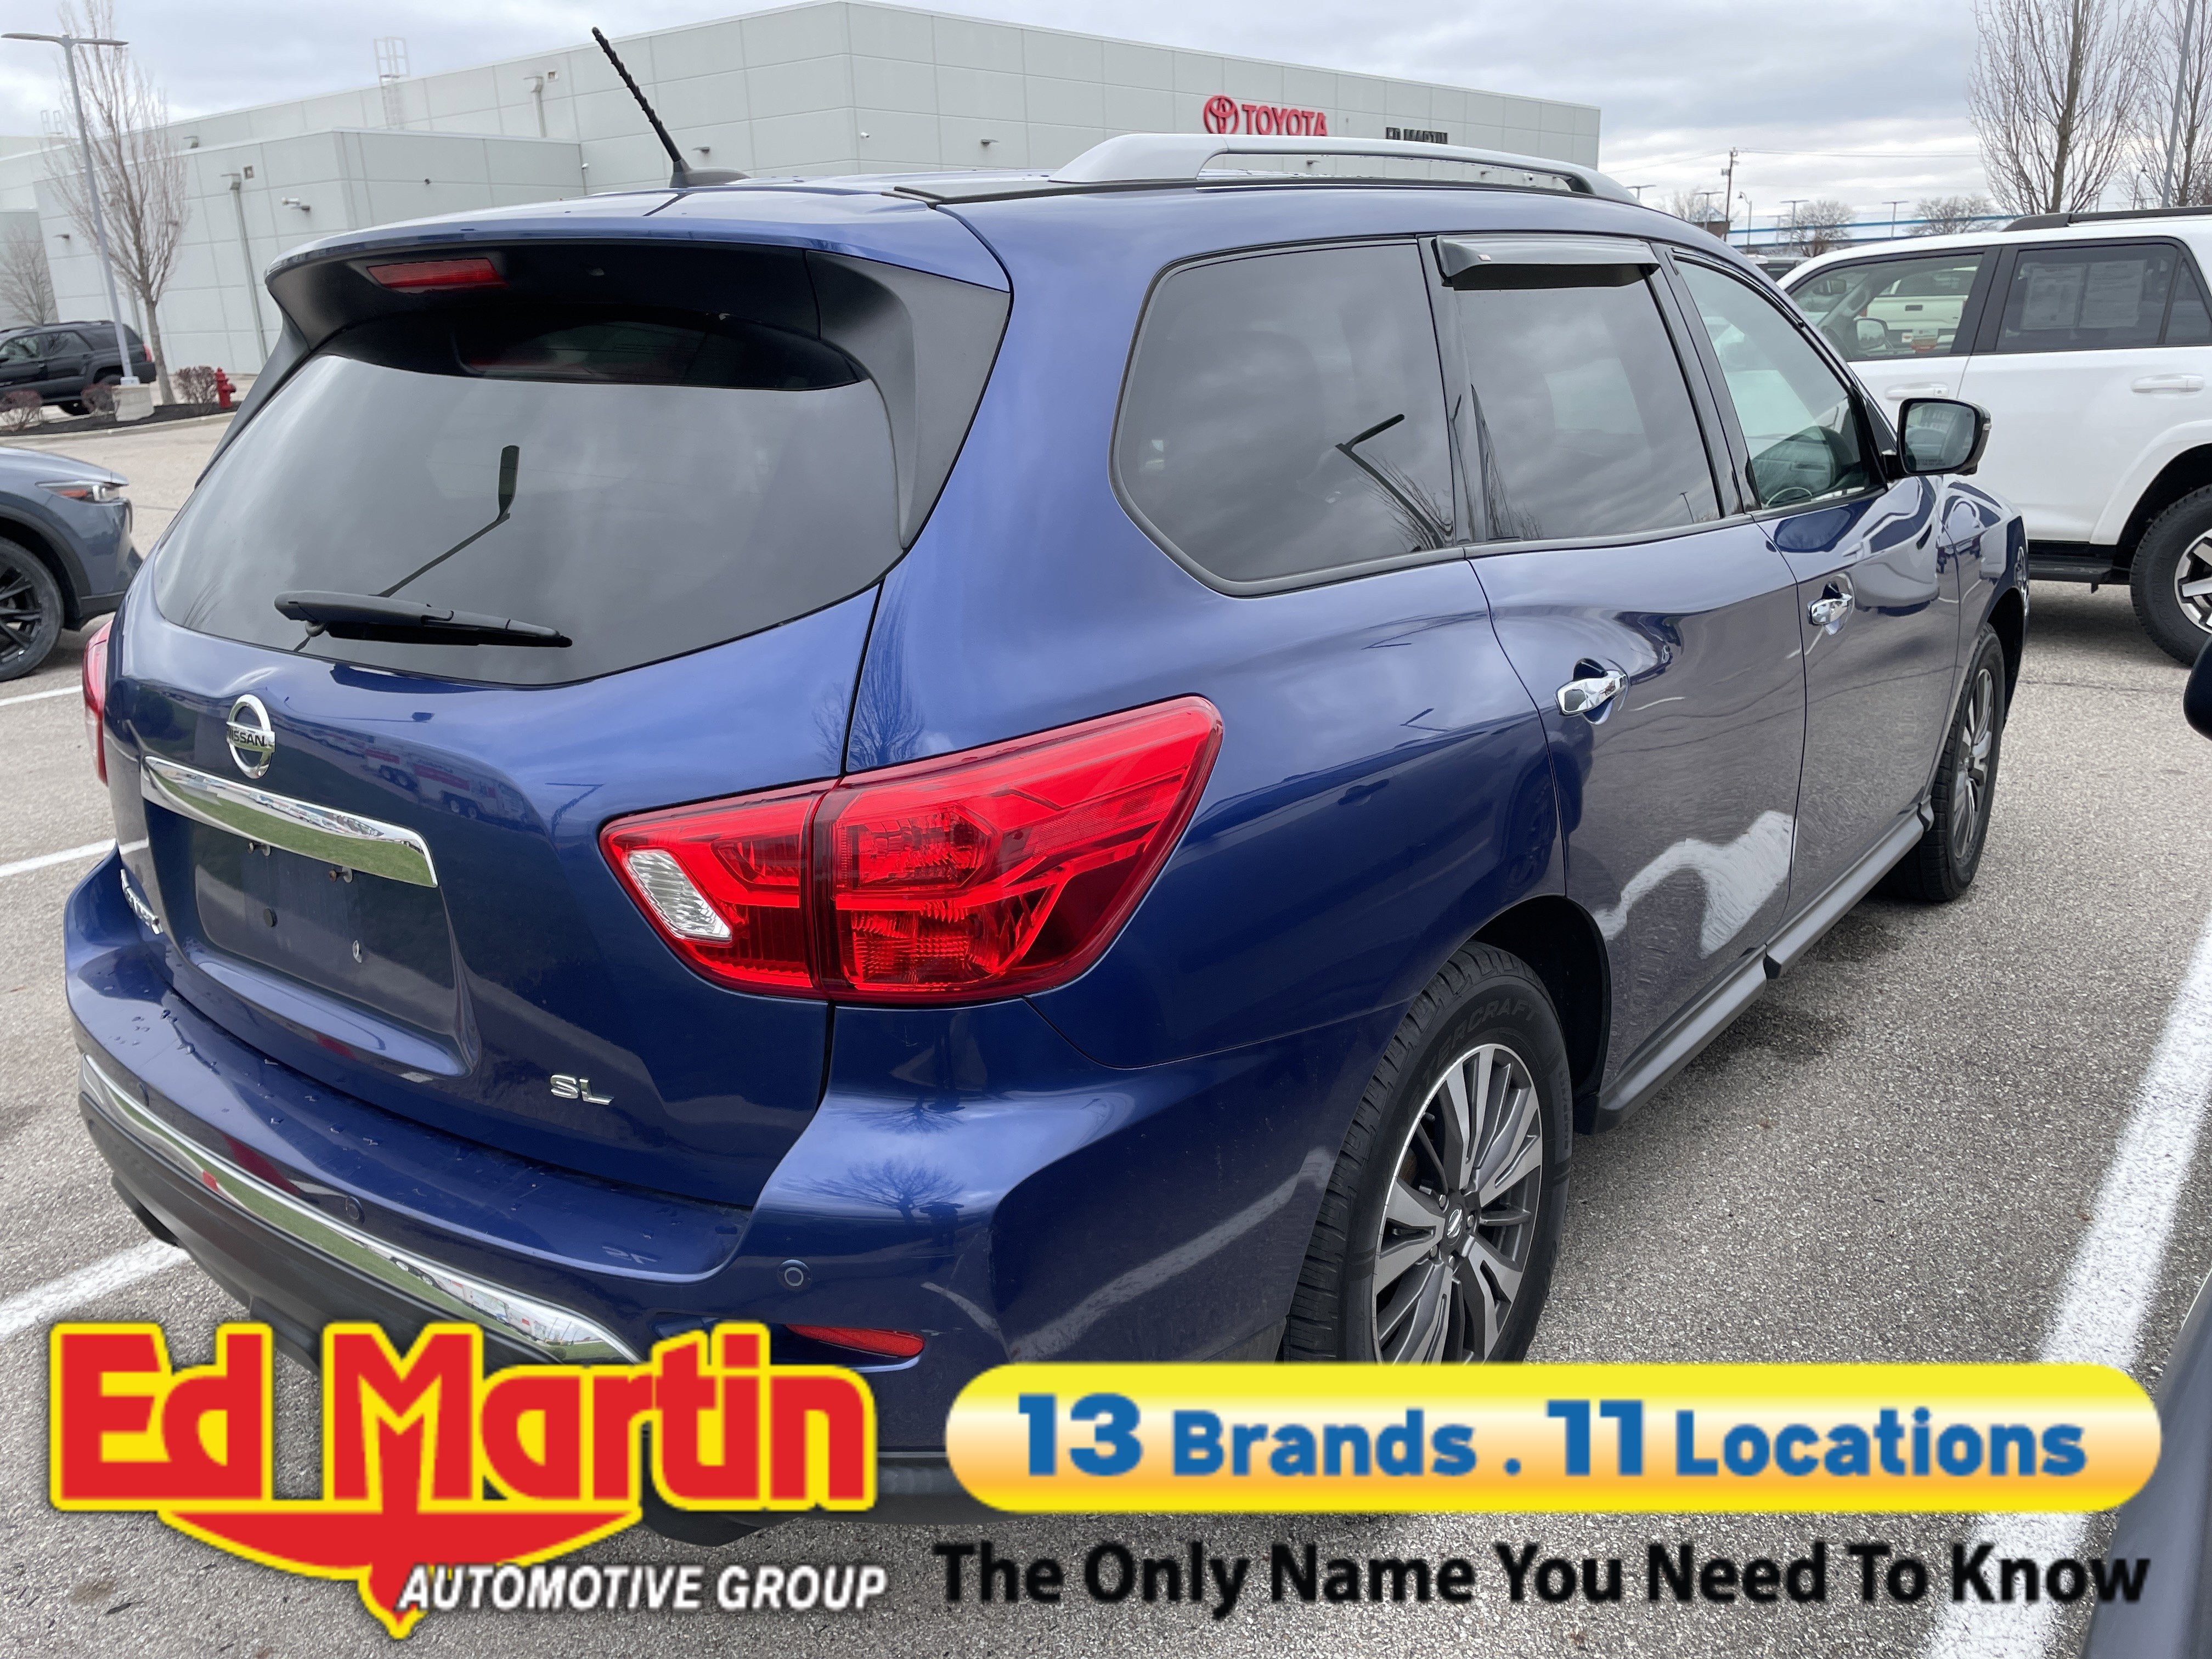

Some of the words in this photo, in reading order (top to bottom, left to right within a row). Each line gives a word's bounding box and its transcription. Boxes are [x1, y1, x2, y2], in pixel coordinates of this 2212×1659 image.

[1242, 104, 1328, 136] TOYOTA
[227, 726, 264, 747] NISSAN
[550, 1074, 614, 1105] SL
